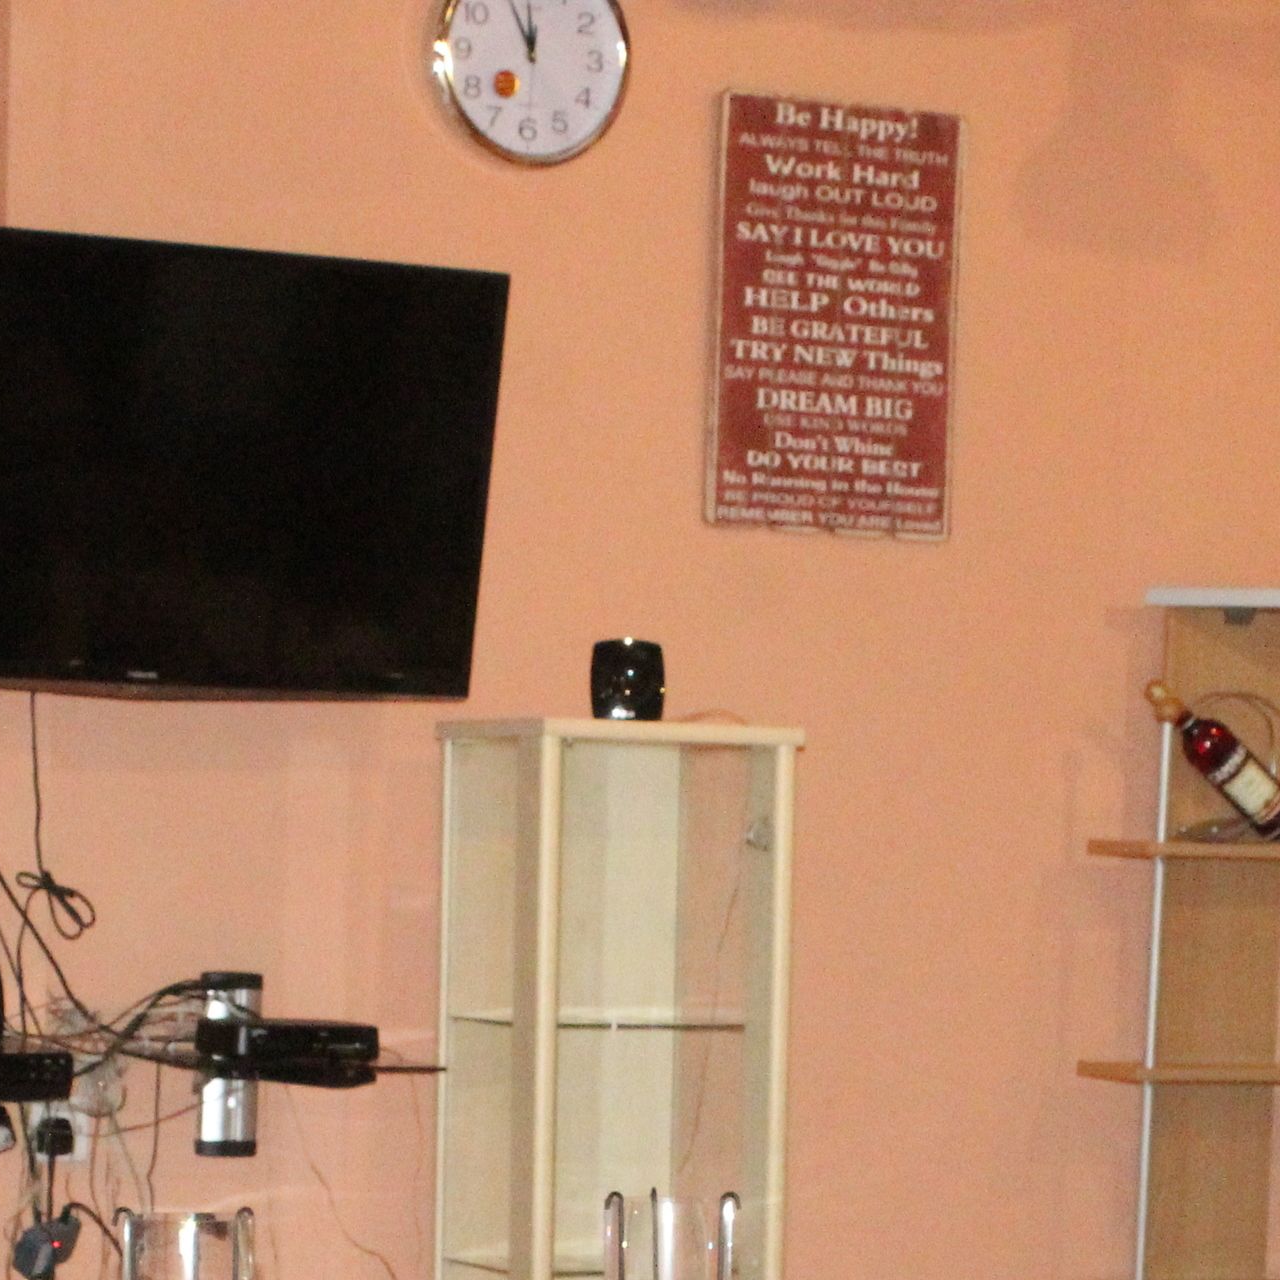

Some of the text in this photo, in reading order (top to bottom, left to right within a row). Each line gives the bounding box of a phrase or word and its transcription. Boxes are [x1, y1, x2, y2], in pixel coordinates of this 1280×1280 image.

[464, 2, 488, 25] 10
[577, 12, 595, 35] 2
[454, 36, 471, 60] 9
[587, 51, 603, 73] 3
[464, 75, 481, 98] 8
[575, 87, 592, 108] 4
[487, 105, 502, 126] 7
[552, 110, 568, 133] 5
[776, 103, 918, 141] Be Happy!
[519, 117, 537, 141] 6
[739, 133, 808, 151] ALWAYS
[765, 154, 920, 190] Work Hard
[816, 185, 864, 204] OUT
[871, 191, 937, 212] LOUD
[737, 222, 944, 259] SAY I LOVE YOU
[806, 272, 839, 290] THE
[847, 277, 921, 297] WORLD
[744, 286, 935, 323] HELP Others
[751, 315, 928, 349] BE GRATEFUL
[730, 339, 944, 379] TRY NEW Things
[724, 365, 754, 380] SAY
[758, 367, 816, 386] PLEASE
[822, 373, 853, 389] AND
[912, 380, 944, 397] YOU
[757, 387, 913, 420] DREAM BIG
[774, 431, 894, 457] Don't Whine
[747, 450, 921, 478] DO YOUR BEST
[723, 470, 747, 484] No
[751, 472, 826, 492] Running
